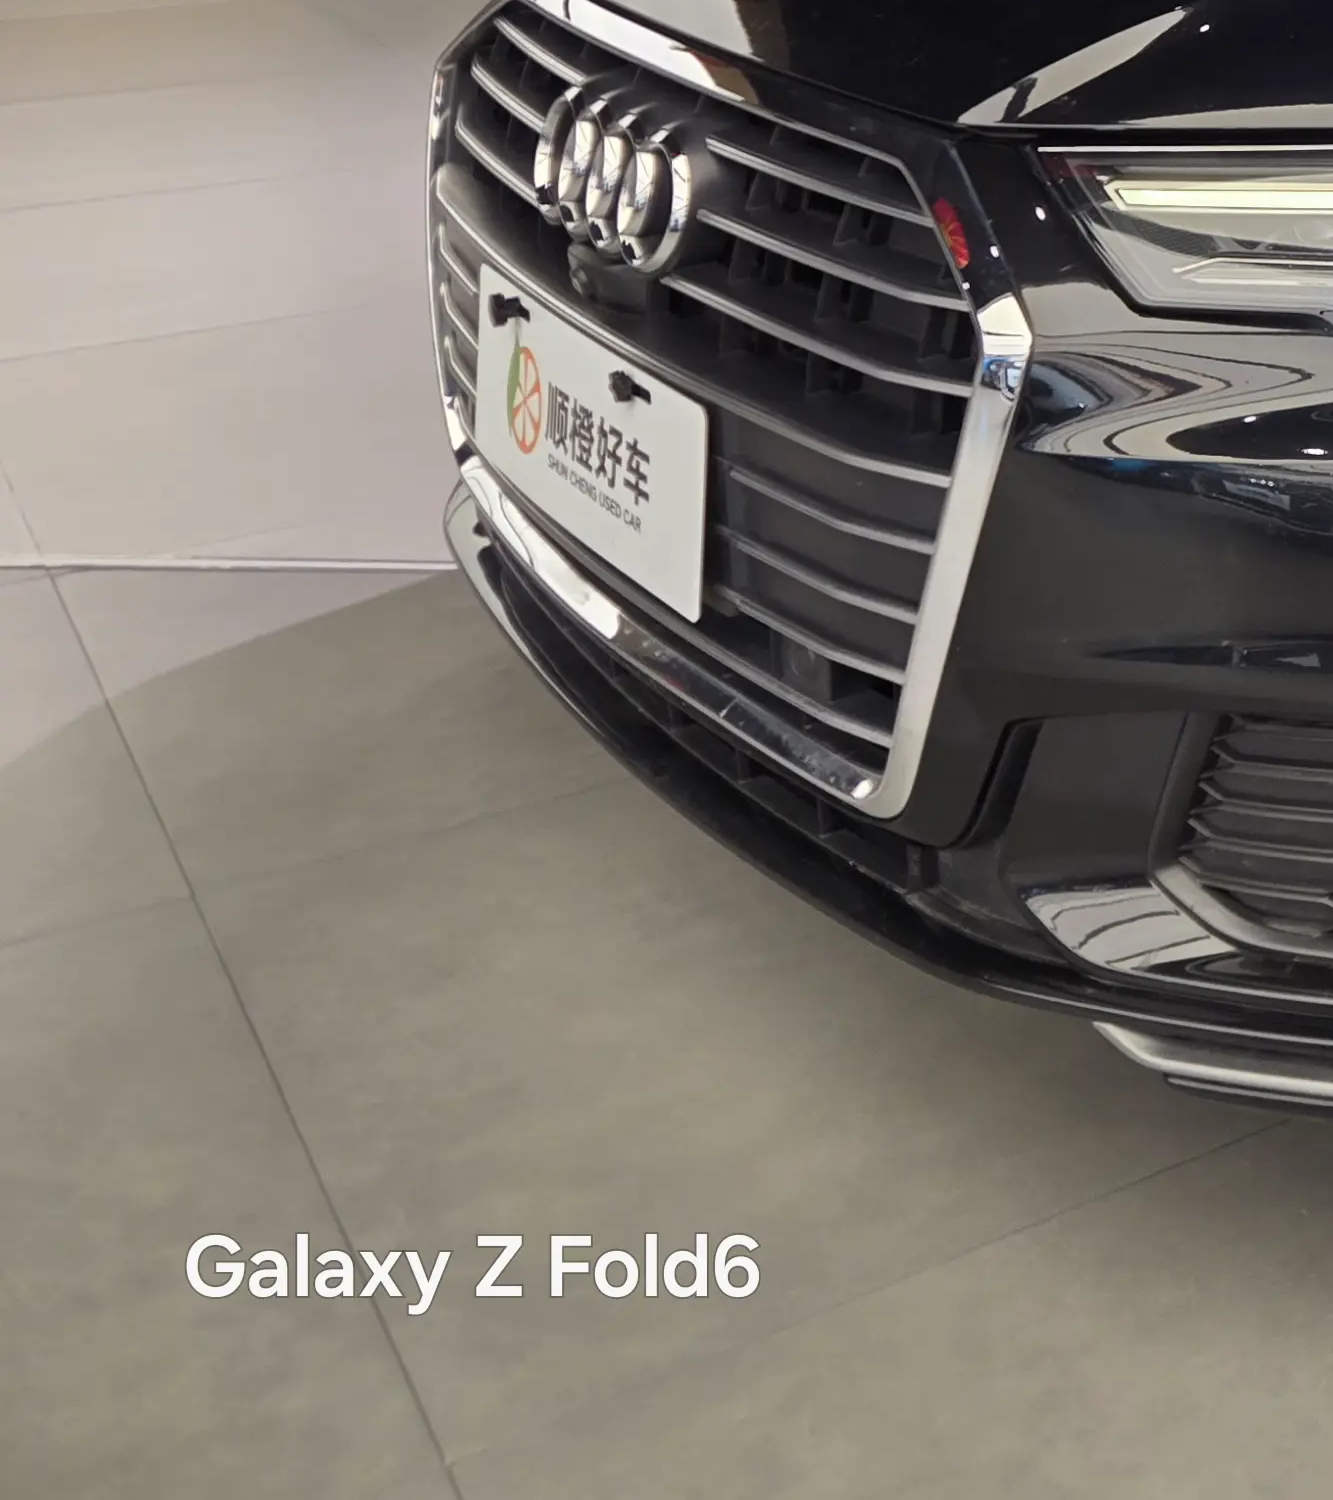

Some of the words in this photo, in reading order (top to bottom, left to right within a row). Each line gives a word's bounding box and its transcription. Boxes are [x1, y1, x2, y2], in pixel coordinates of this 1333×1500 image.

[545, 381, 650, 506] 顺橙好车
[547, 453, 569, 481] SHUN
[569, 470, 597, 502] CHENG
[598, 489, 622, 520] USED
[622, 508, 642, 534] CAR
